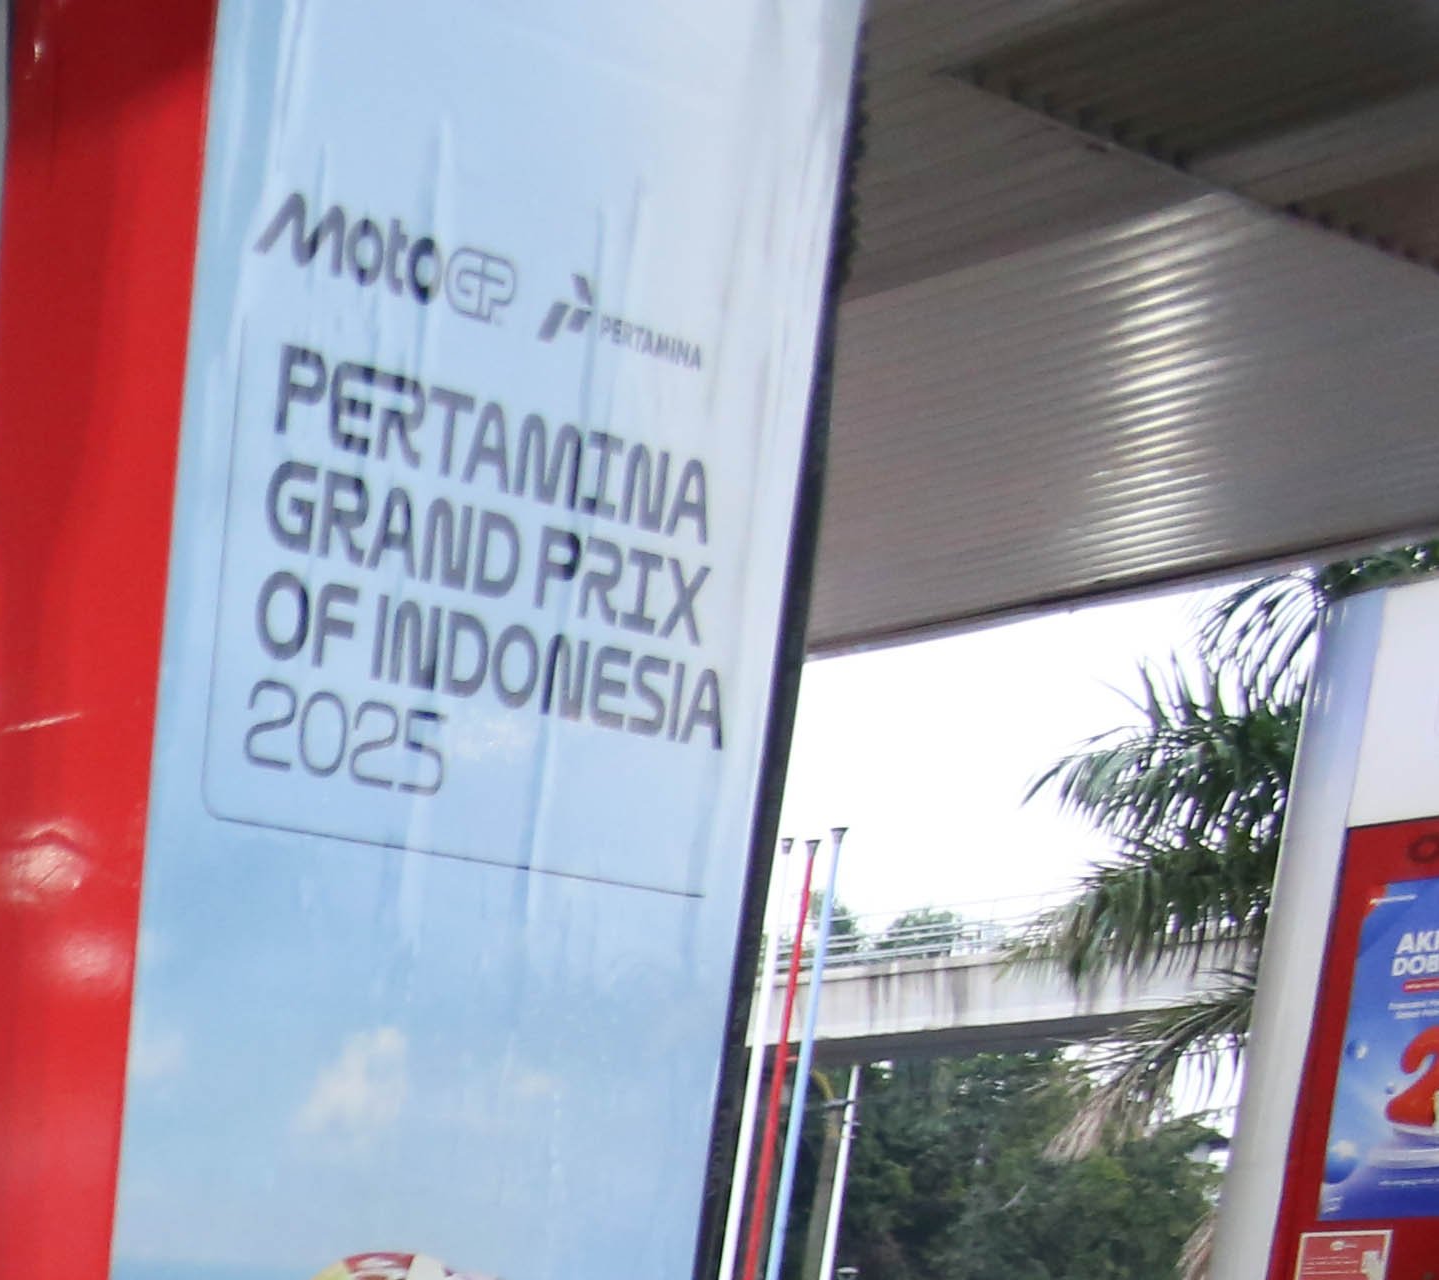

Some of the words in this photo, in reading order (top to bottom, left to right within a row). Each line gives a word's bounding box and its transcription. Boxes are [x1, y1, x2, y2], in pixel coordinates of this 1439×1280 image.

[253, 192, 517, 323] MotoGP
[599, 313, 703, 371] PERTAMINA
[274, 343, 709, 545] PERTAMINA
[266, 460, 521, 600] GRAND
[533, 524, 711, 646] PRIX
[243, 679, 450, 796] 2025
[256, 570, 360, 669] OF
[371, 593, 724, 751] INDONESIA
